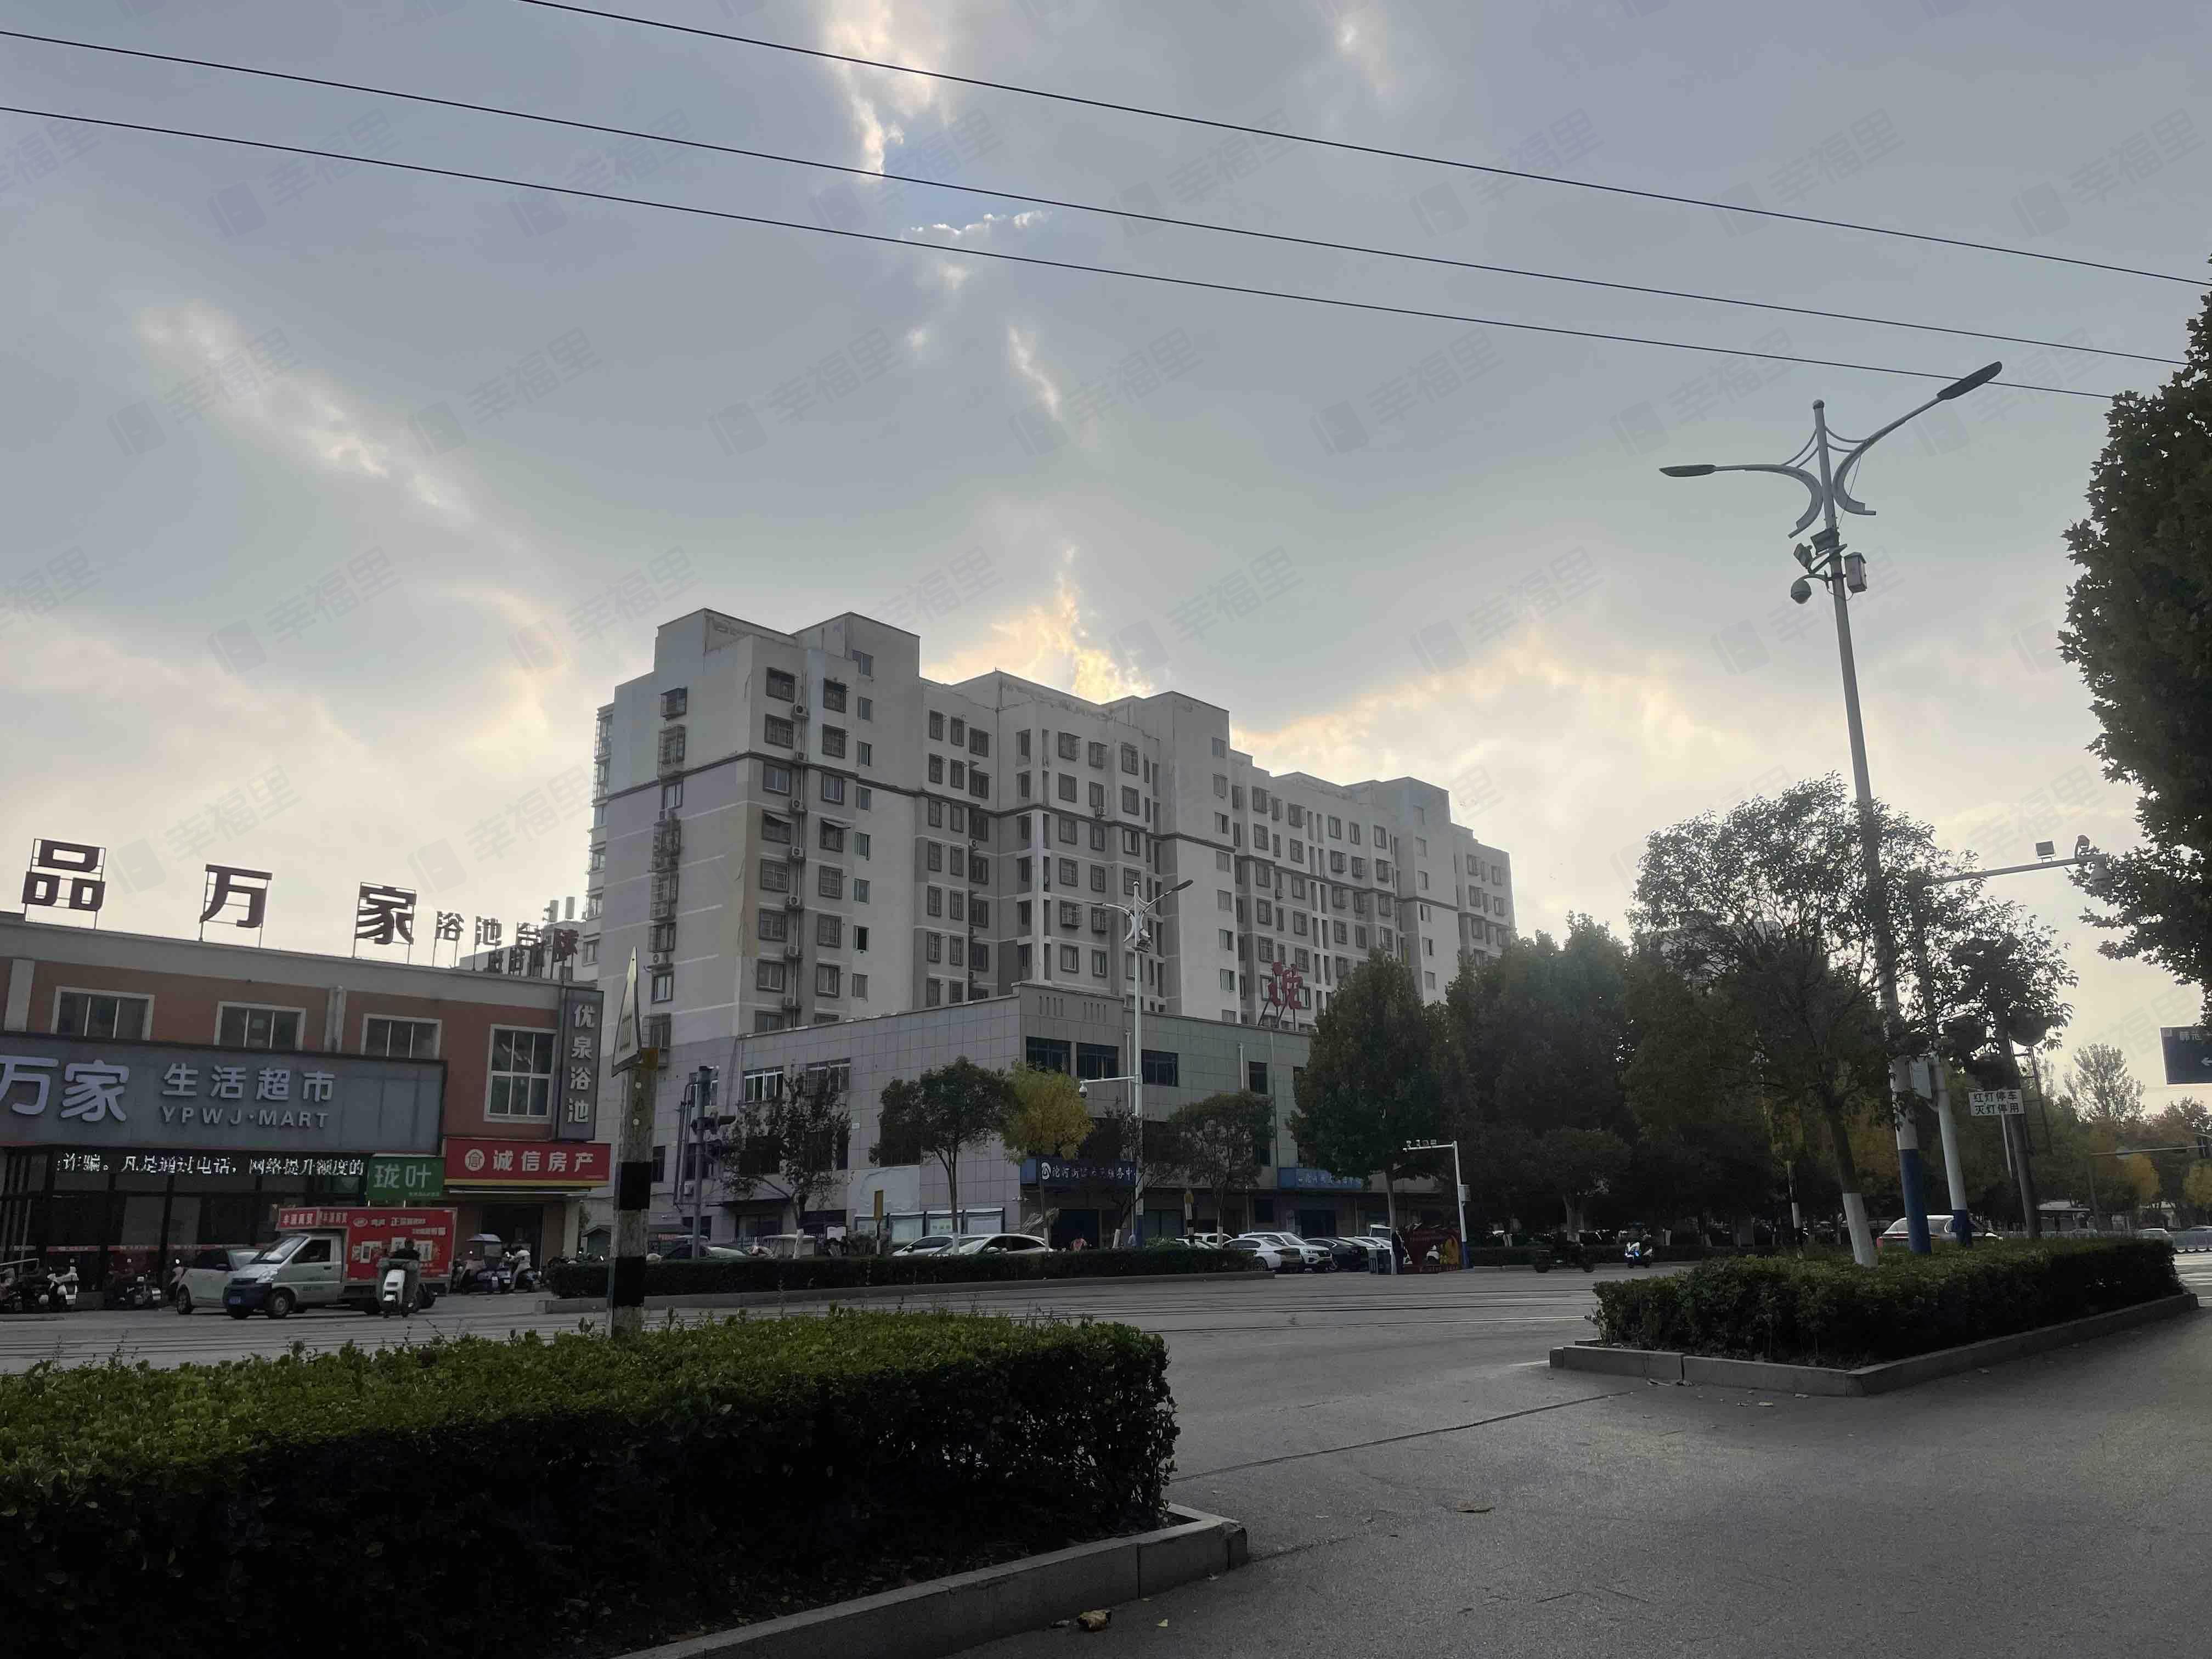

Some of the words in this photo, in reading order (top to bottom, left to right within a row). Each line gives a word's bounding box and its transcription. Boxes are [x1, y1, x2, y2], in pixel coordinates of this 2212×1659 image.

[567, 1005, 594, 1124] 优泉浴池
[0, 1055, 129, 1122] 万家
[162, 1063, 335, 1102] 生活超市
[1974, 1091, 2017, 1102] 红灯停车
[1975, 1103, 2019, 1115] 灭灯停用
[493, 1150, 594, 1172] 诚信房产
